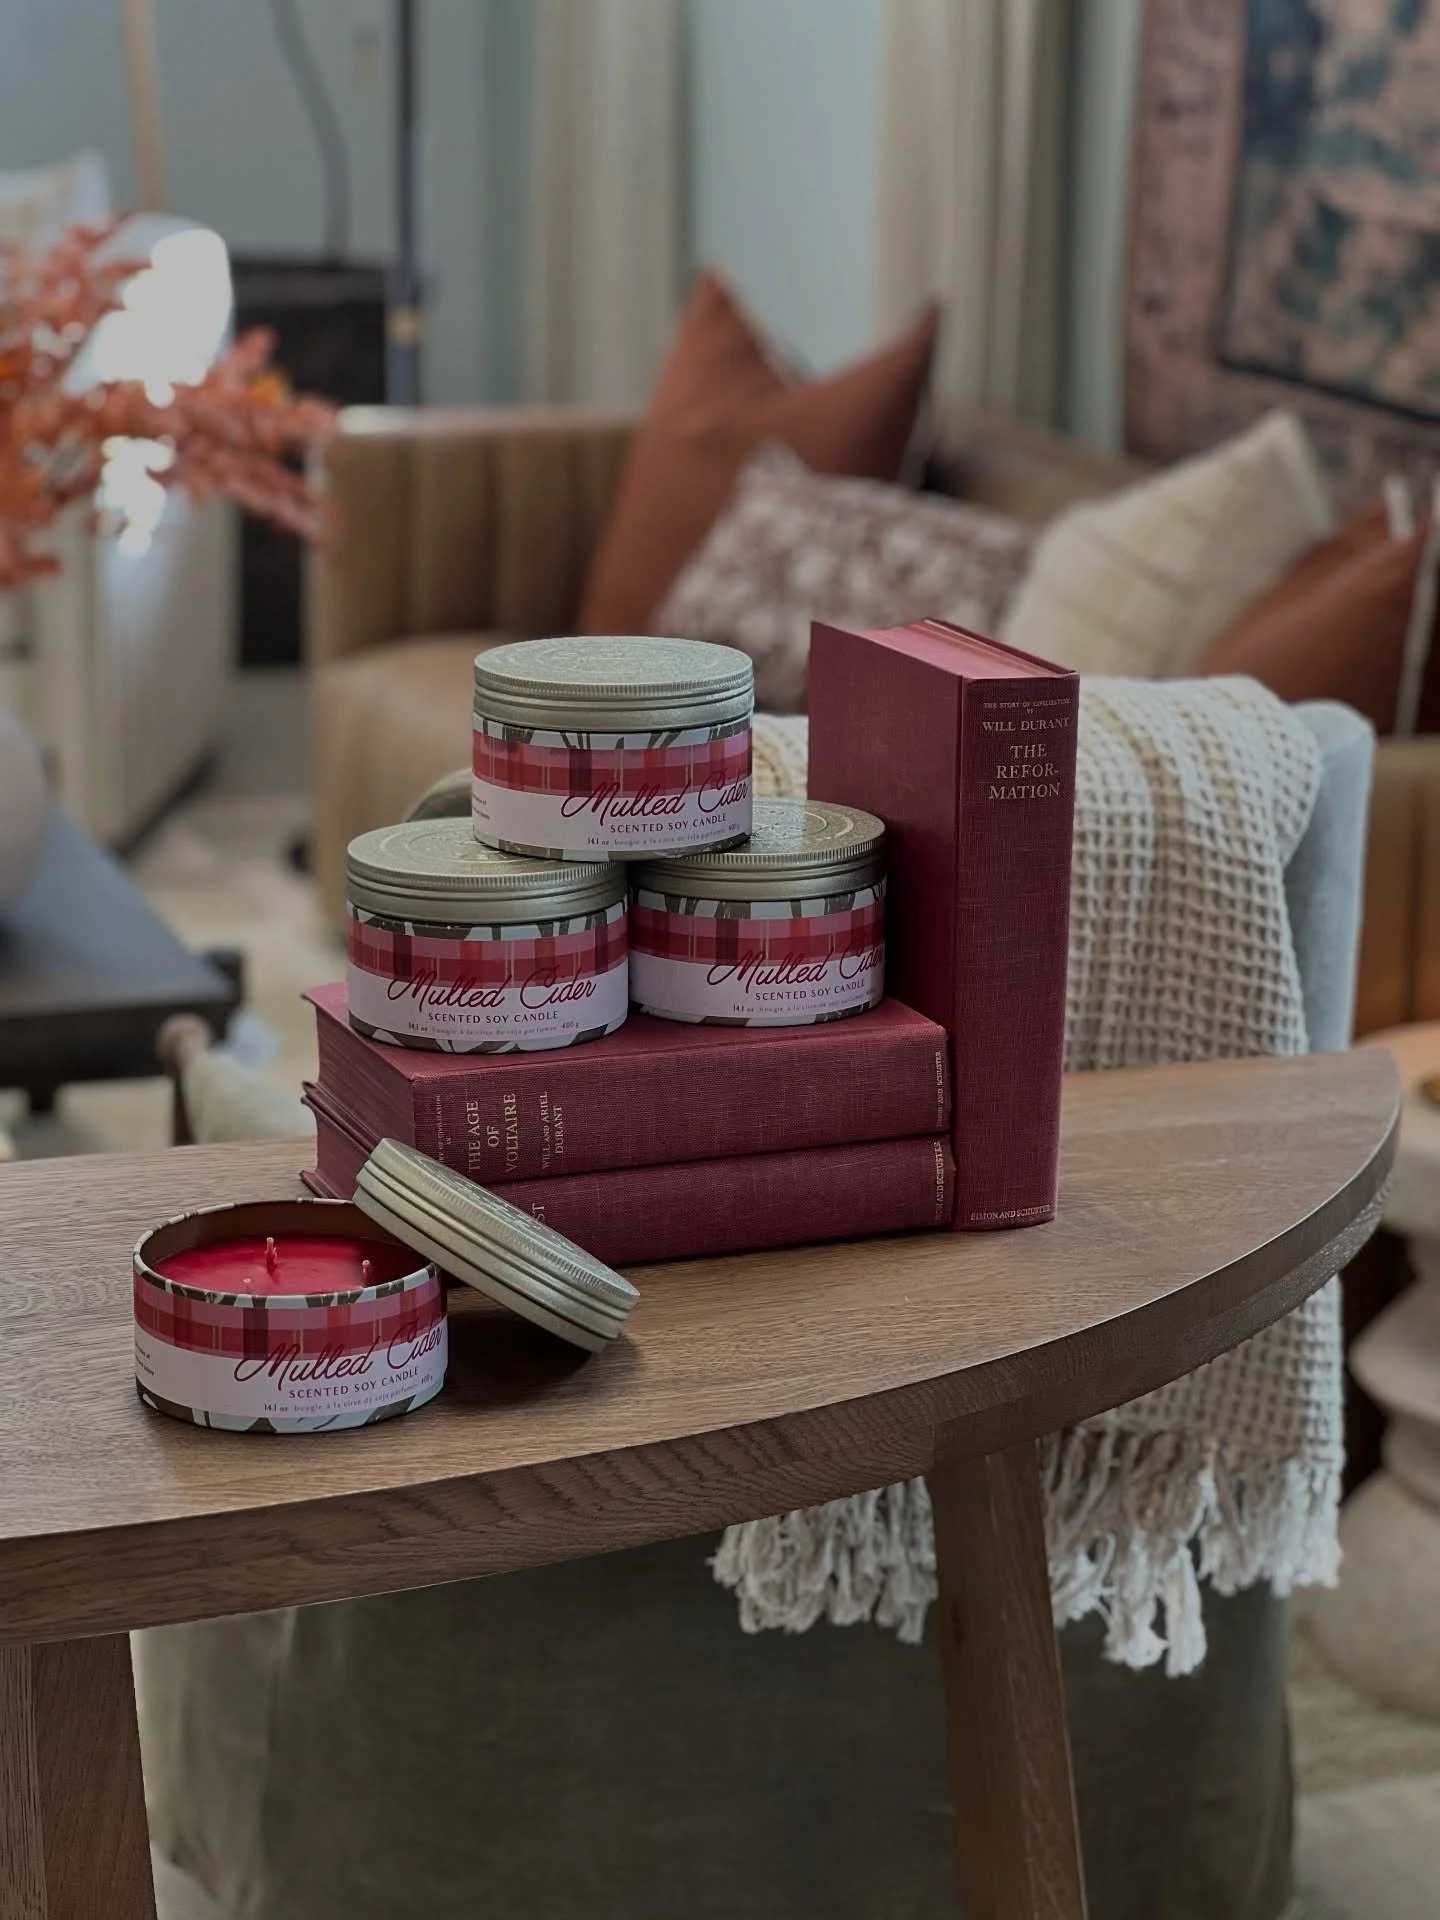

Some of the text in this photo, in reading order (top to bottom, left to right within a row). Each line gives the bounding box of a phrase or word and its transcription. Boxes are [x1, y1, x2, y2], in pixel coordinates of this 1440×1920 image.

[982, 717, 1070, 731] WILL DURANT
[1009, 744, 1048, 759] THE
[996, 763, 1059, 779] REFOR-
[561, 767, 749, 826] Mulled Cider
[989, 782, 1060, 799] MATION
[610, 812, 727, 834] SCENTED SOY CANDLE
[706, 947, 835, 994] Mulled
[387, 964, 597, 1012] Mulled Cider
[755, 989, 807, 1000] SCENTED
[811, 987, 831, 998] SOY
[834, 979, 865, 994] CANDLE
[428, 1010, 559, 1024] SCENTED SOY CANDLE
[935, 1051, 943, 1086] SCHUSTER
[467, 1100, 481, 1171] THE AGE
[487, 1125, 500, 1148] OF
[503, 1093, 519, 1172] VOLTAIRE
[539, 1092, 551, 1170] WILL AND ARIEL
[553, 1105, 564, 1154] DURANT
[936, 1185, 944, 1202] AND
[999, 1210, 1016, 1219] AND
[1016, 1204, 1051, 1217] SCHUSTER
[233, 1313, 443, 1391] Mulled Cider
[289, 1366, 419, 1399] SCENTED SOY CANDLE
[264, 1403, 277, 1412] 14.1
